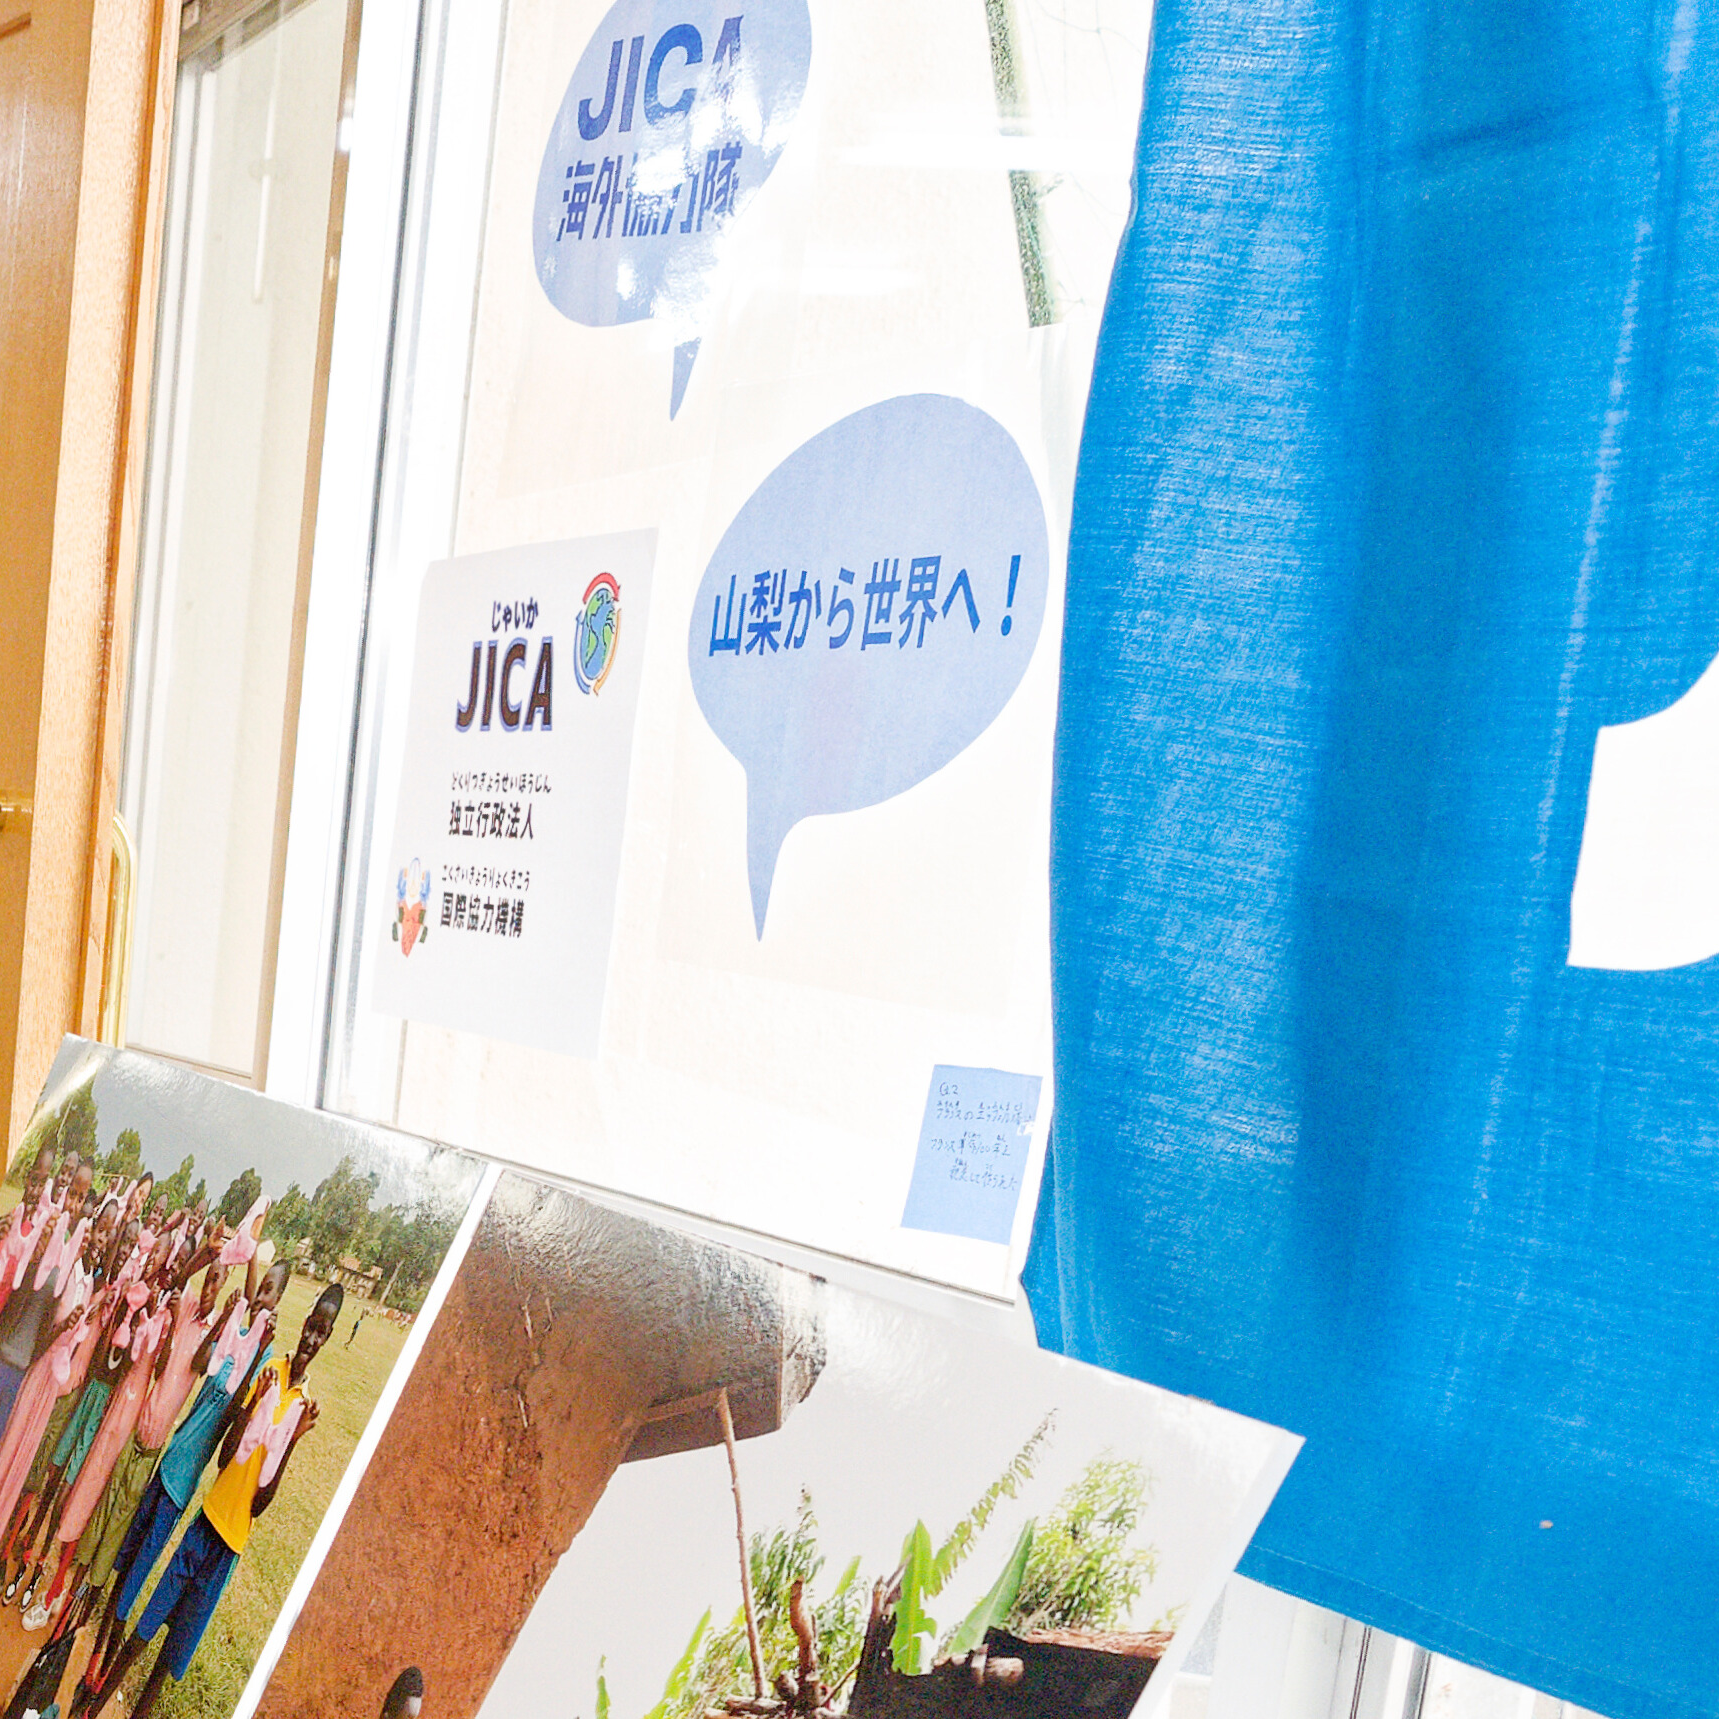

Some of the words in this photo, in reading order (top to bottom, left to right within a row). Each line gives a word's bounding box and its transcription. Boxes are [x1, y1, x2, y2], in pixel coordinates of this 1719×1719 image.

[492, 597, 539, 633] じゃいか
[709, 555, 1021, 658] 山梨から世界へ！
[455, 636, 553, 732] JICA
[451, 771, 552, 794] どくりつぎょうせいほうじん
[448, 800, 534, 840] 独立行政法人
[441, 864, 530, 892] こくさいきょうりょくきこう
[440, 891, 525, 938] 国際協力機構
